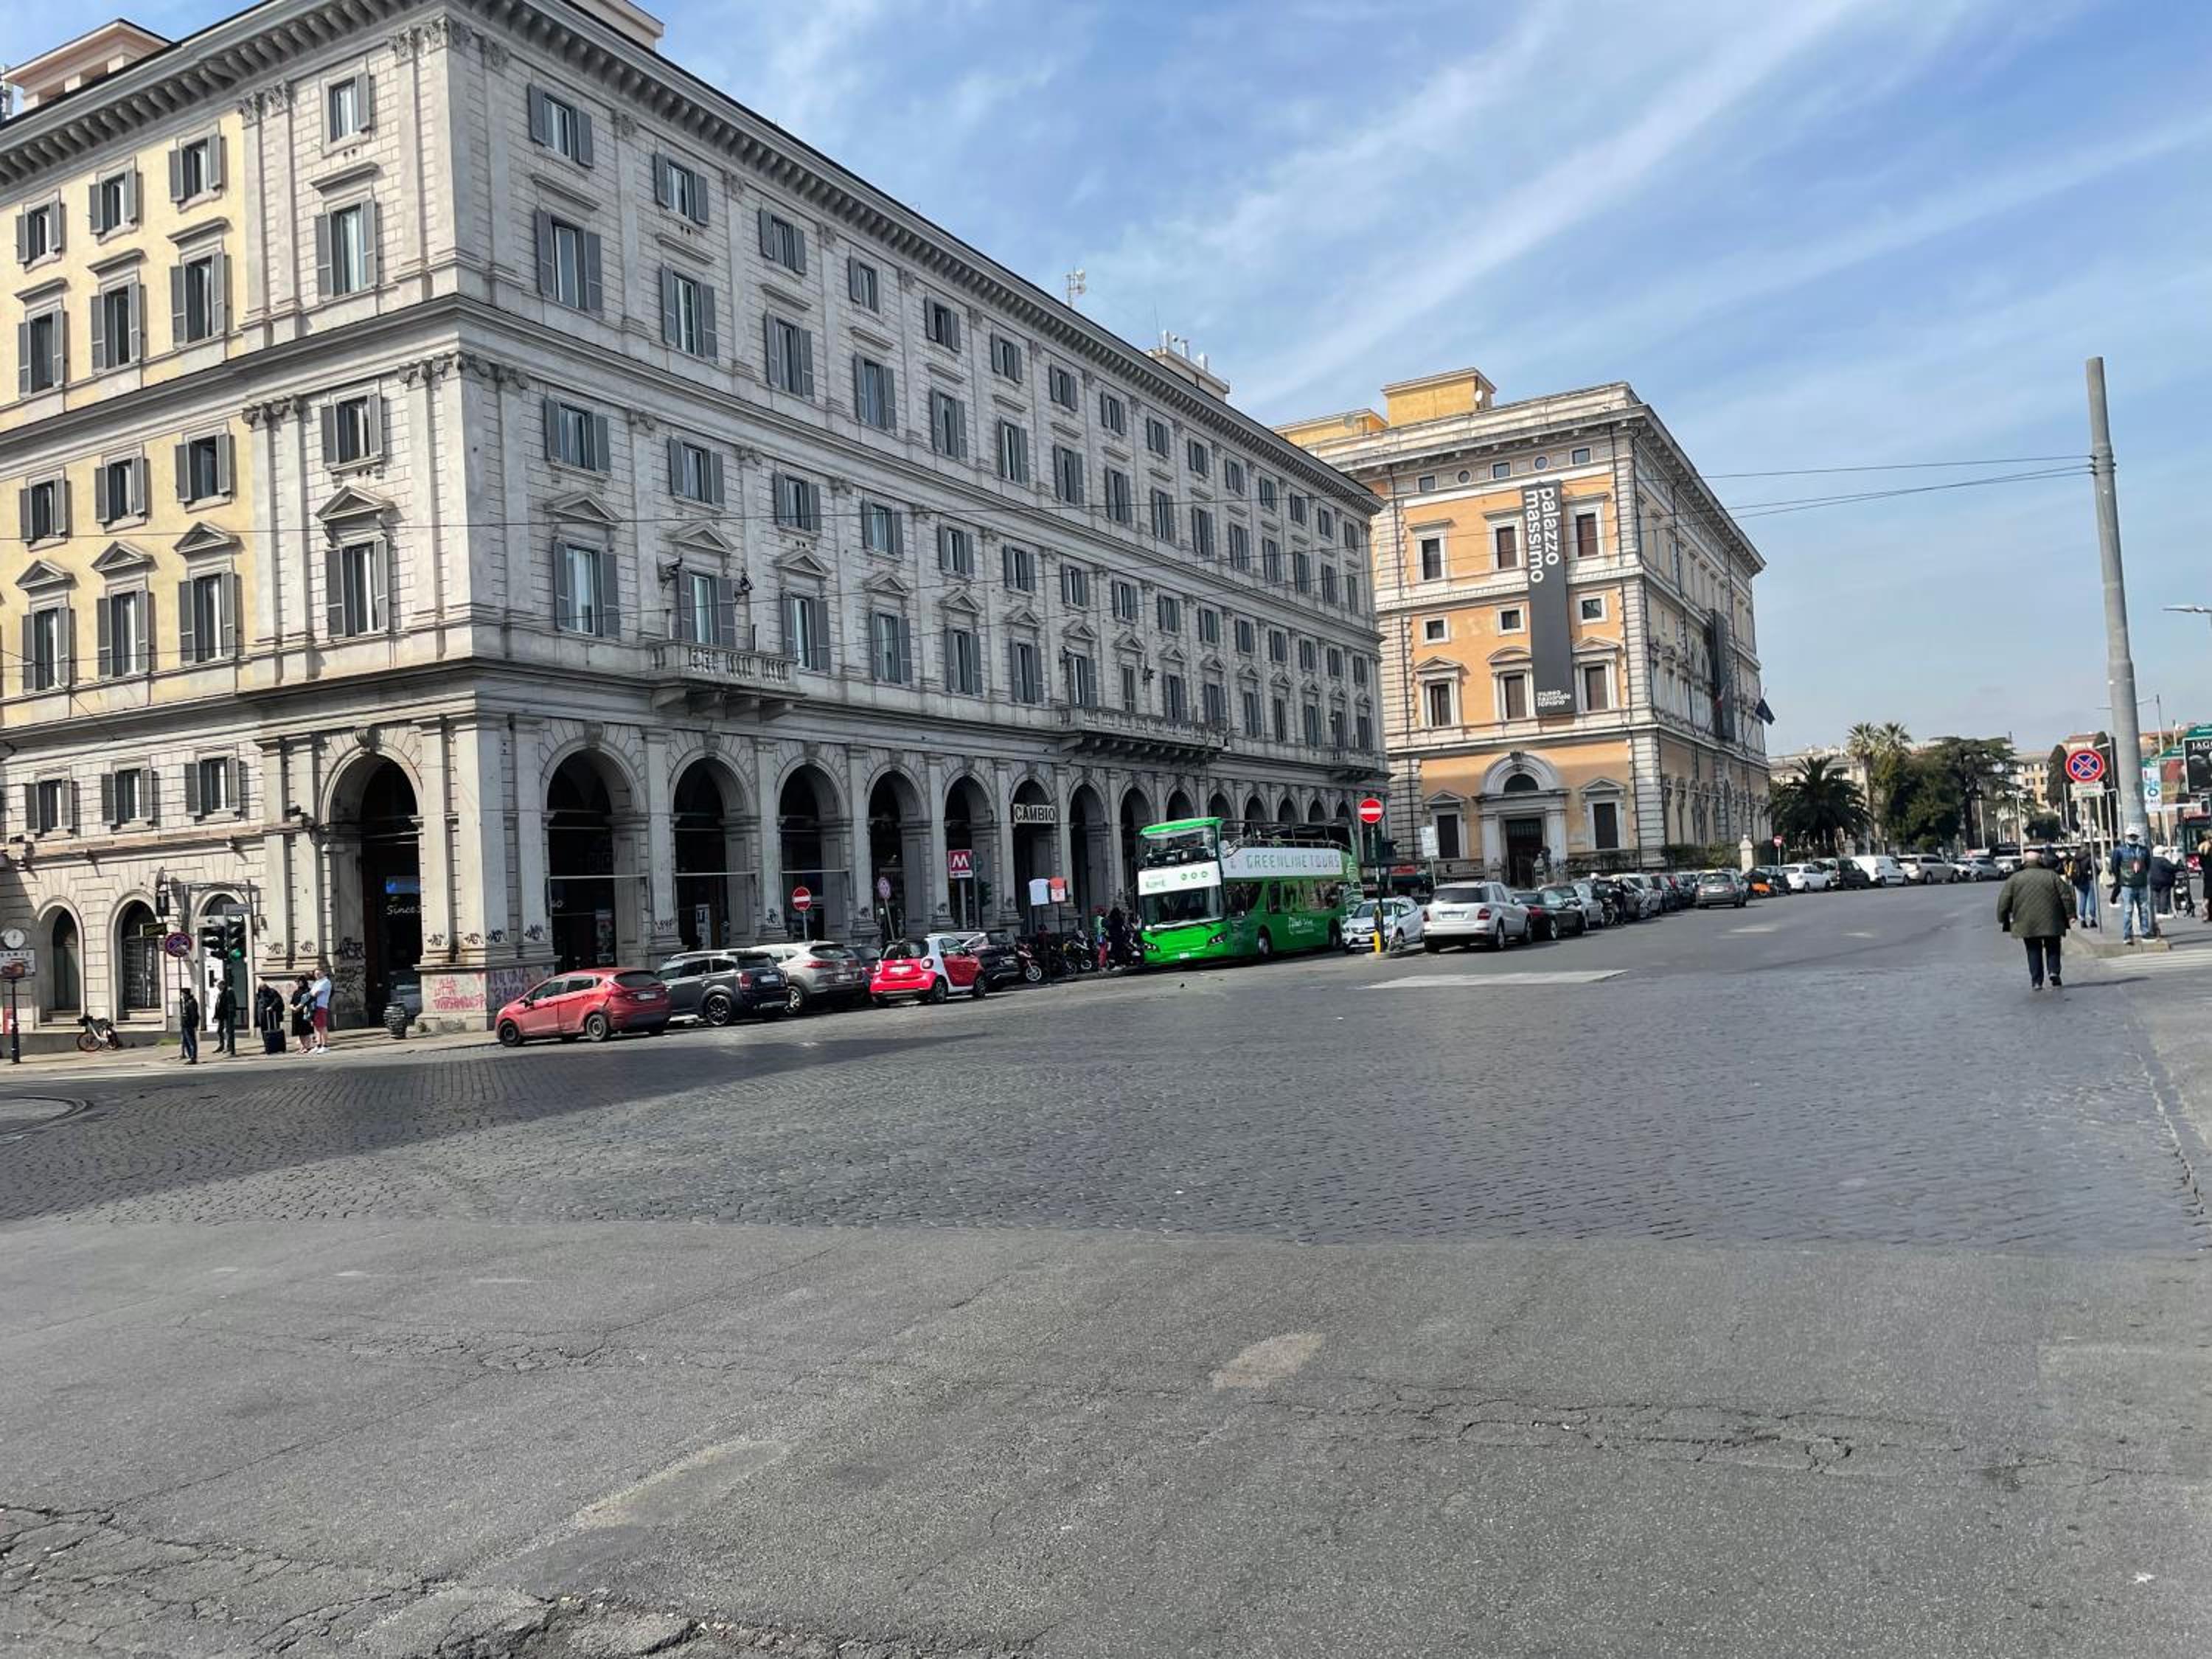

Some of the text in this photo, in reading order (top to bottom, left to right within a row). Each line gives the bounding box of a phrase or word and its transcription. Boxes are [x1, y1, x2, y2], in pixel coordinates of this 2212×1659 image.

[1540, 487, 1561, 566] palazzo
[1525, 490, 1544, 582] massimo
[1015, 807, 1055, 821] CAMBIO
[952, 854, 970, 868] M
[1246, 854, 1307, 869] GREENLINE
[1310, 854, 1340, 868] TOURS
